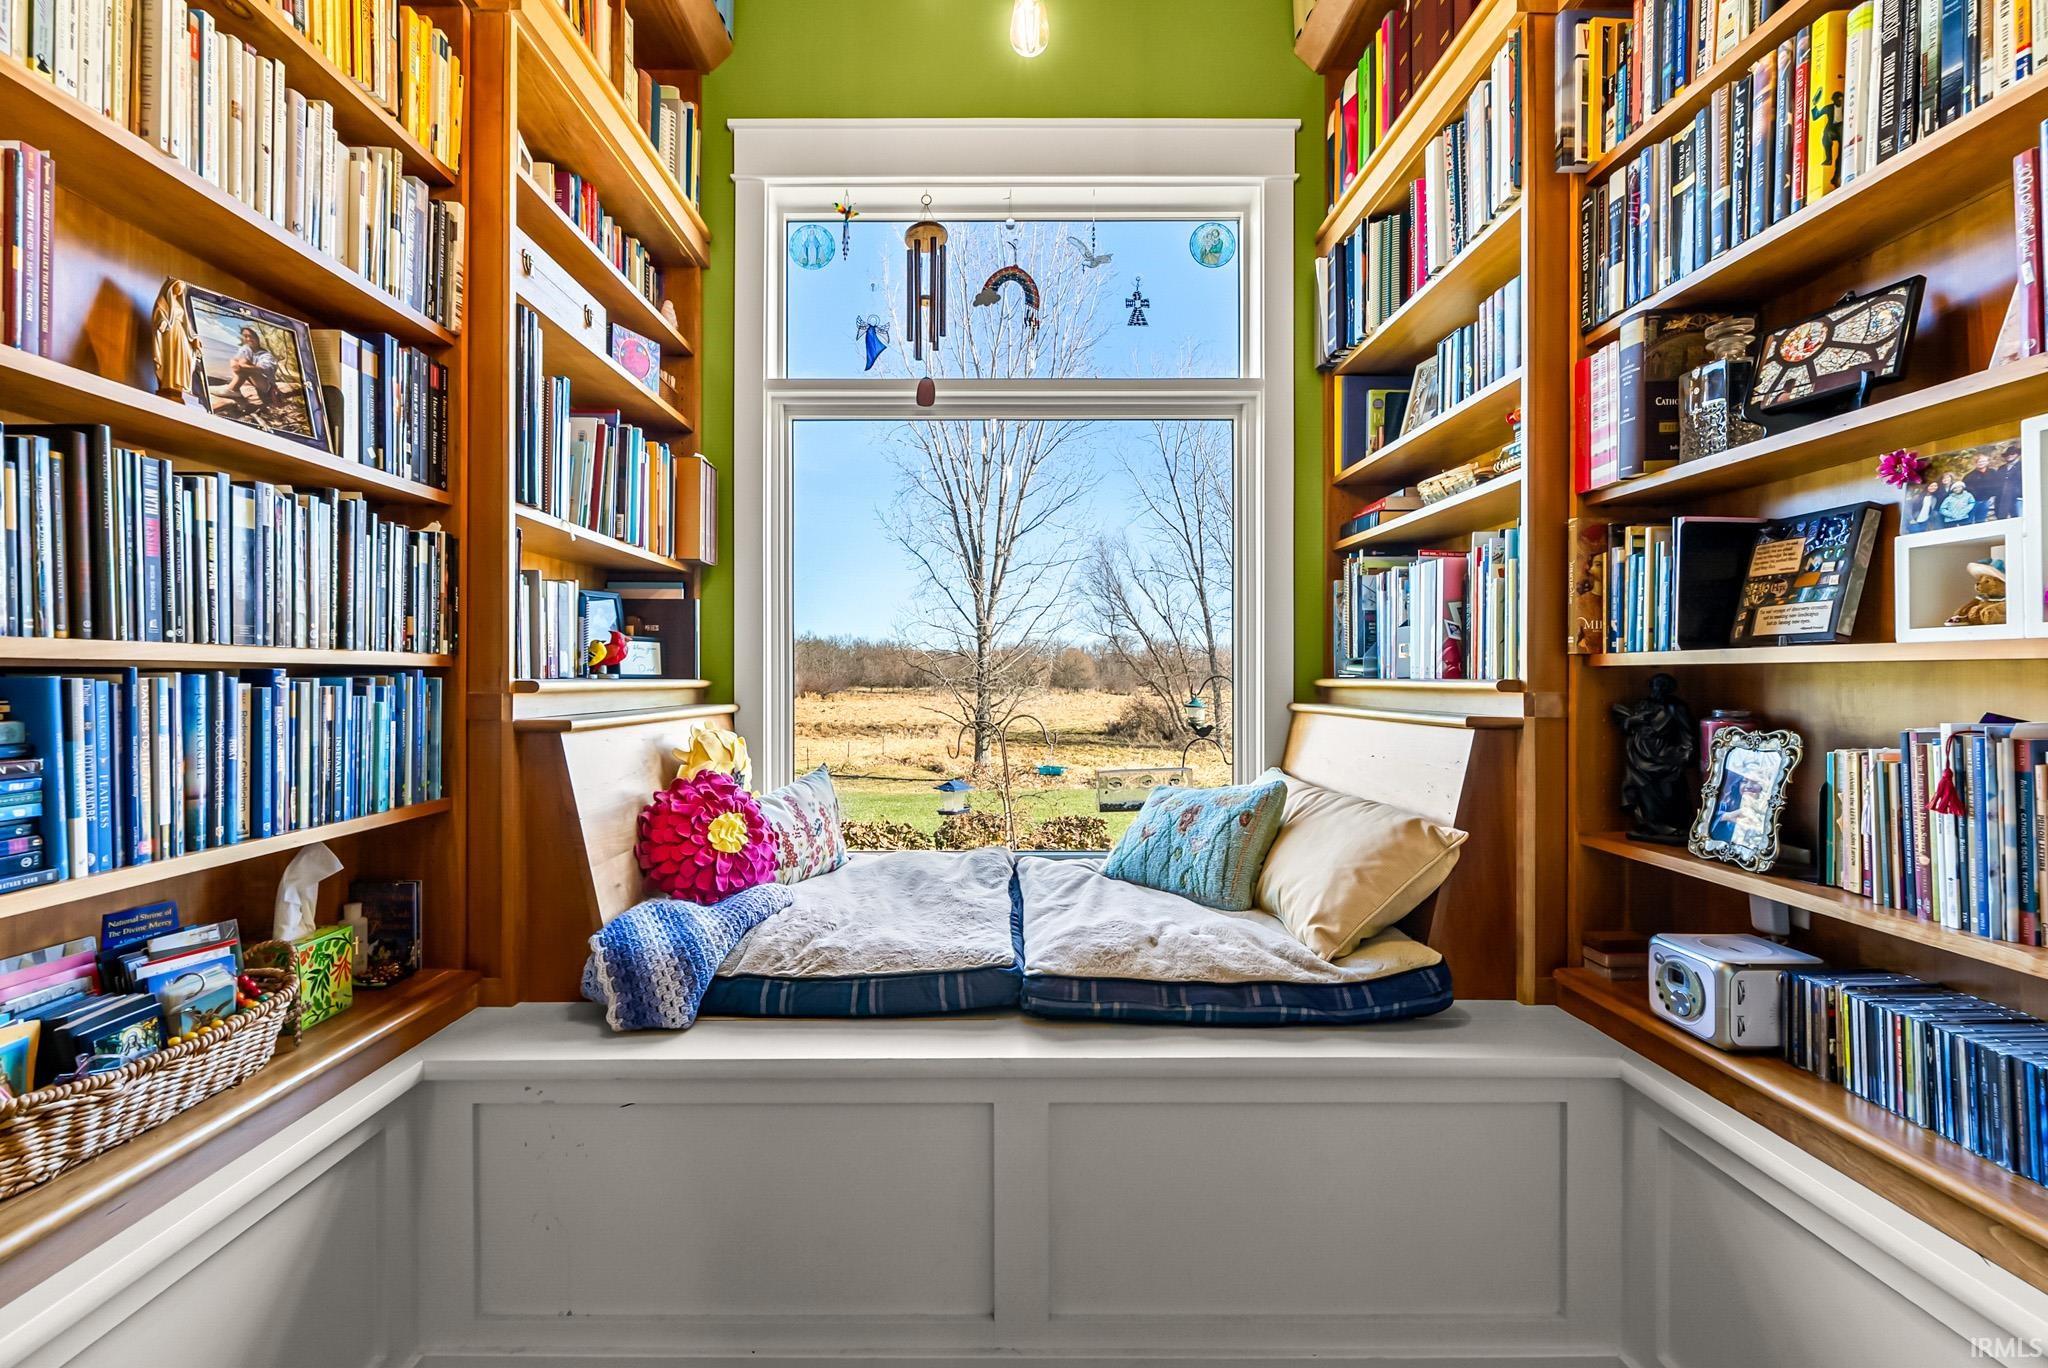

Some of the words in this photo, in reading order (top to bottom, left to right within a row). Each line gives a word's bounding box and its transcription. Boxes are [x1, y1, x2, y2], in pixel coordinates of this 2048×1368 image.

[1928, 20, 1936, 49] OCEAN
[1882, 51, 1897, 88] THOMAS
[1906, 53, 1914, 99] CIVILIZATION
[1720, 88, 1728, 110] DAWN
[1881, 86, 1895, 128] KENEALLY
[1719, 136, 1727, 161] KITTY
[1734, 127, 1744, 173] MOON
[1628, 191, 1641, 226] 1776
[27, 220, 34, 231] WE
[26, 251, 34, 260] TO
[144, 464, 158, 486] MAN
[144, 488, 159, 515] MYTH
[145, 517, 160, 557] MESSIAH
[142, 735, 150, 746] TO
[215, 720, 224, 763] BOOKED
[228, 738, 237, 760] MERCY
[215, 766, 224, 788] FOR
[240, 760, 248, 812] Catholicism
[100, 774, 109, 828] FEARLESS
[215, 790, 224, 809] LIFE
[2037, 814, 2045, 841] PRISON
[23, 876, 39, 884] CAHN
[108, 914, 139, 928] National
[140, 912, 163, 921] Shrine
[123, 925, 148, 935] Divine
[148, 920, 172, 929] Mercy
